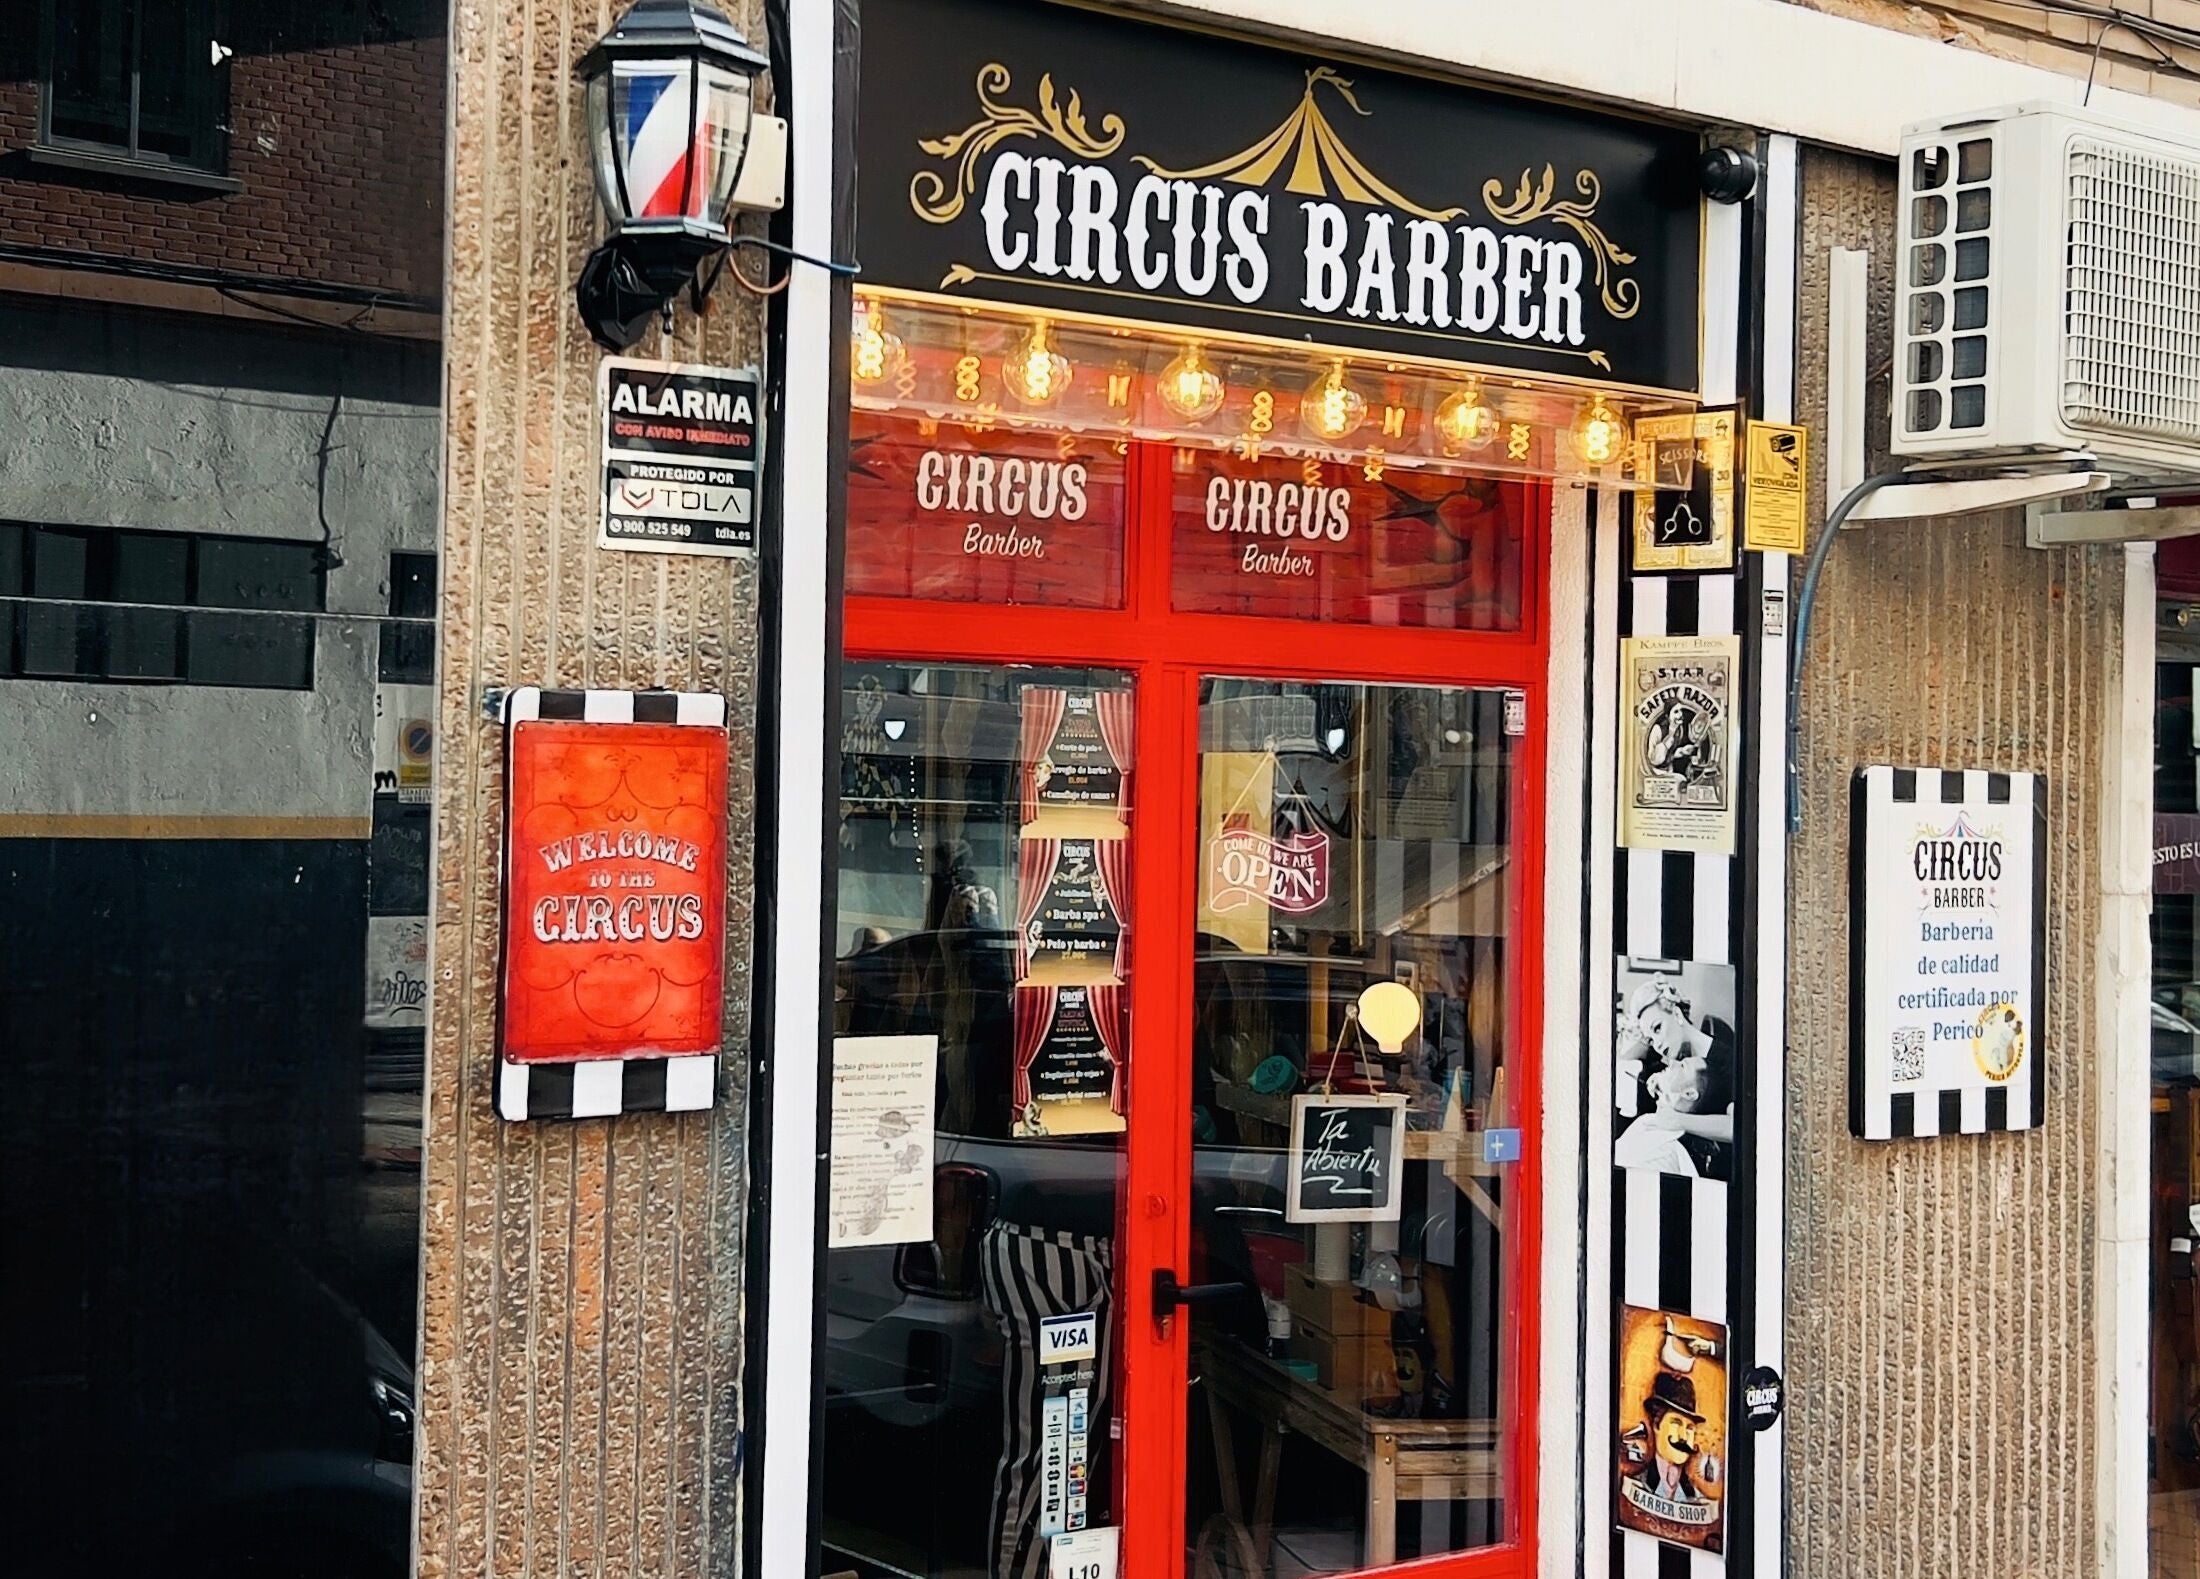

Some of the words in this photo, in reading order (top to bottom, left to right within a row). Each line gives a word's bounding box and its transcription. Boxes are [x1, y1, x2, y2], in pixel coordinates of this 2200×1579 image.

[980, 151, 1271, 304] CIRCUS
[1300, 201, 1585, 346] BARBER
[612, 383, 753, 424] ALARMA
[614, 423, 643, 437] CON
[646, 426, 682, 441] AVISO
[630, 465, 705, 483] PROTEGIDO
[709, 472, 735, 485] POR
[916, 451, 1087, 520] CIRCUS
[1205, 476, 1350, 541] CIRCUS
[623, 520, 645, 533] 900
[648, 522, 668, 535] 525
[671, 524, 691, 537] 549
[715, 527, 751, 541] tdla.es
[963, 523, 1045, 559] Barber
[1242, 544, 1314, 576] Barber
[1658, 667, 1704, 678] STAR
[1640, 686, 1680, 719] SAFETY
[1683, 686, 1719, 720] RAZOR
[539, 829, 700, 873] WELCOME
[1224, 838, 1254, 852] COME
[1274, 849, 1288, 866] WE
[1292, 854, 1315, 868] ARE
[1913, 840, 2002, 881] CIRCUS
[2180, 842, 2193, 860] ES
[589, 869, 612, 888] TO
[619, 870, 656, 888] THE
[1222, 851, 1316, 901] OPEN
[1934, 887, 1985, 908] BARBER
[533, 894, 703, 942] CIRCUS
[1053, 909, 1081, 920] Barba
[1083, 911, 1099, 922] spa
[1046, 939, 1066, 949] Pelo
[1067, 940, 1074, 950] y
[1074, 940, 1100, 950] barba
[1918, 956, 1936, 975] de
[1941, 954, 1999, 974] calidad
[1898, 987, 1985, 1009] certificada
[1991, 989, 2018, 1010] por
[1933, 1020, 1984, 1041] Perico
[1319, 1108, 1349, 1144] Ta
[1048, 1327, 1088, 1348] VISA
[1041, 1370, 1076, 1385] Accepted
[1078, 1370, 1095, 1380] here
[1633, 1488, 1675, 1518] BARBER
[1679, 1506, 1707, 1521] SHOP
